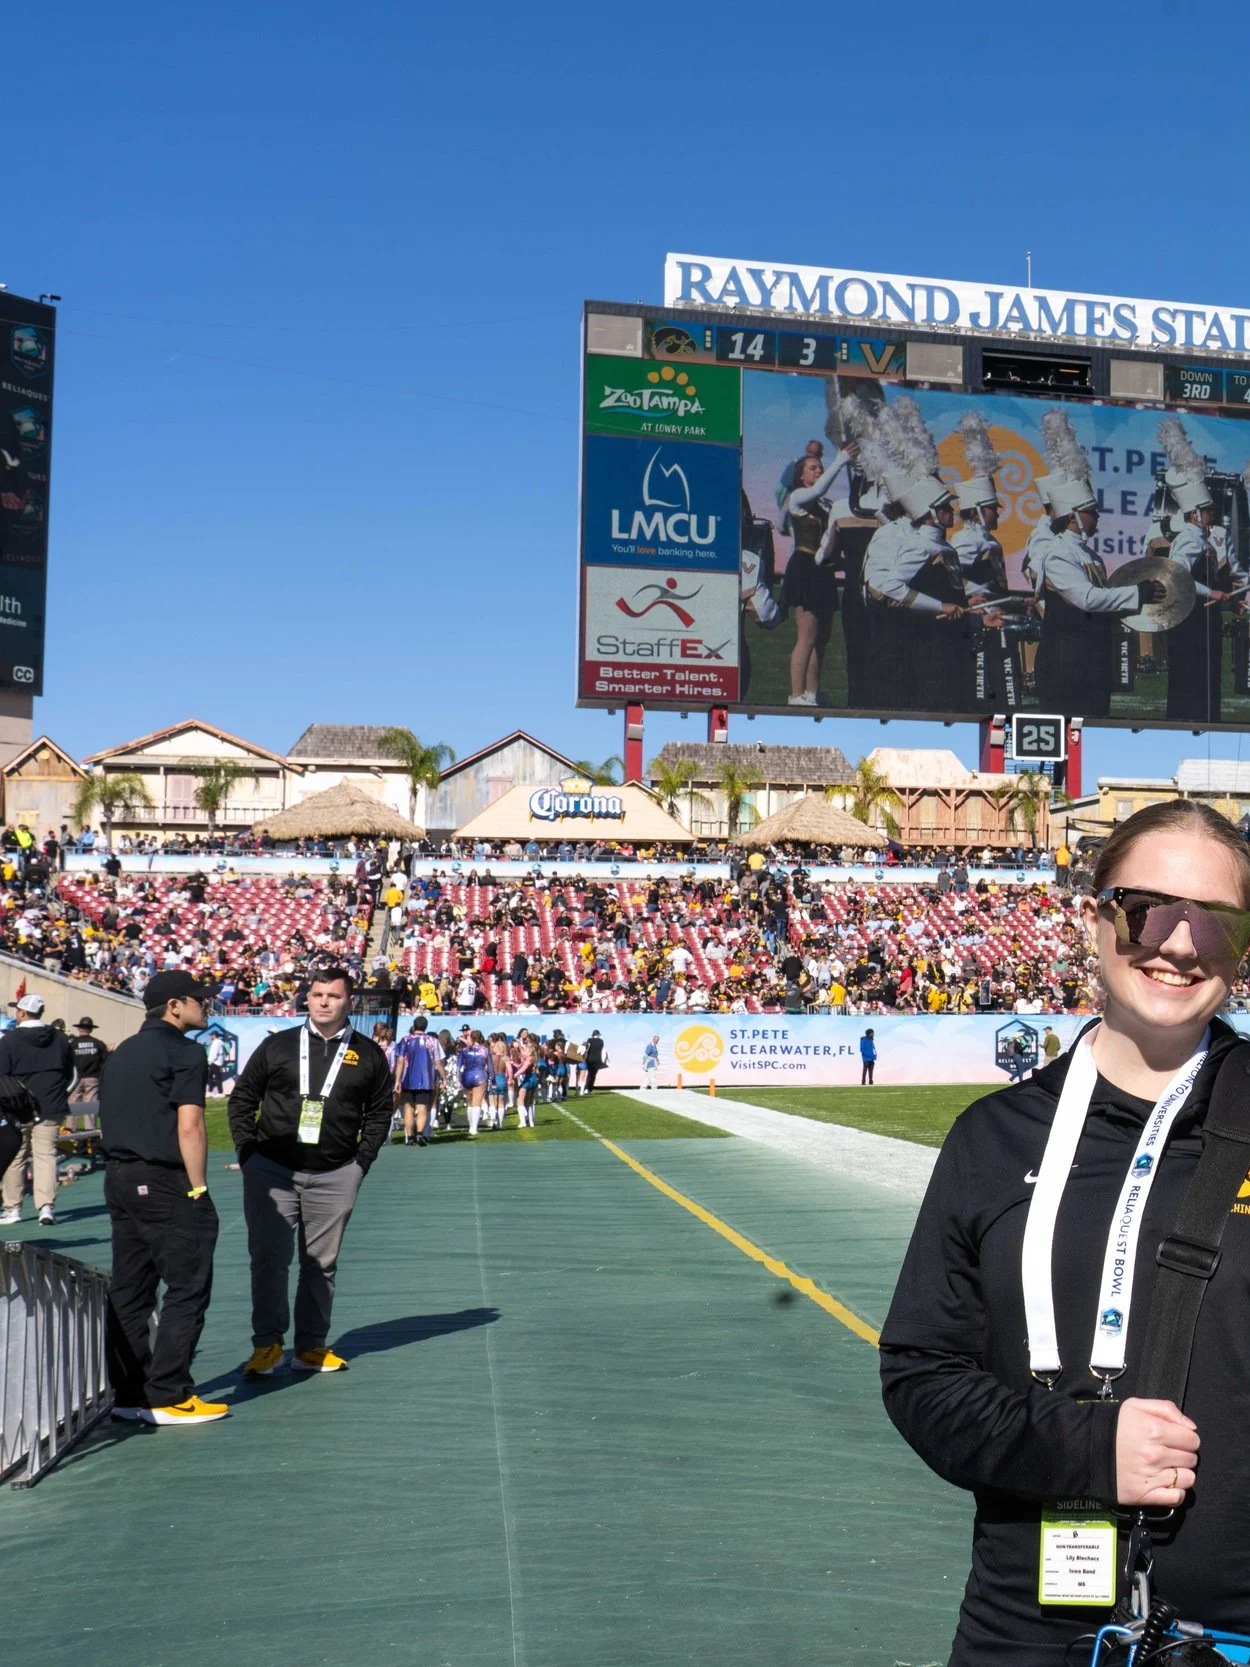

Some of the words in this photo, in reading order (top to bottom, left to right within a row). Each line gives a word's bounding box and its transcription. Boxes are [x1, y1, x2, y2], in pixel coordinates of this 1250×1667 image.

[675, 261, 960, 325] RAYMOND
[968, 291, 1138, 340] JAMES
[728, 332, 764, 361] 14
[800, 338, 817, 366] 3
[1180, 370, 1212, 382] DOWN
[1234, 375, 1248, 386] TO
[1182, 383, 1210, 400] 3RD
[641, 422, 652, 432] AT
[655, 424, 682, 435] LOWRY
[684, 426, 706, 436] PARK
[612, 544, 636, 553] You'll
[636, 545, 656, 554] love
[658, 547, 694, 559] banking
[696, 550, 717, 558] here.
[14, 666, 34, 682] CC
[600, 667, 659, 680] Better
[663, 670, 724, 682] Talent.
[595, 681, 671, 694] Smarter
[676, 684, 727, 696] Hires.
[1022, 725, 1054, 751] 25
[529, 788, 622, 822] Corona
[730, 1029, 788, 1040] ST.PETE
[730, 1060, 806, 1070] VisitSPC.com
[1176, 1083, 1190, 1094] TO
[1146, 1094, 1180, 1146] UNIVERSITIES
[1116, 1185, 1140, 1255] RELIAQUEST
[1111, 1258, 1125, 1298] BOWL
[1057, 1500, 1102, 1510] SIDELINE
